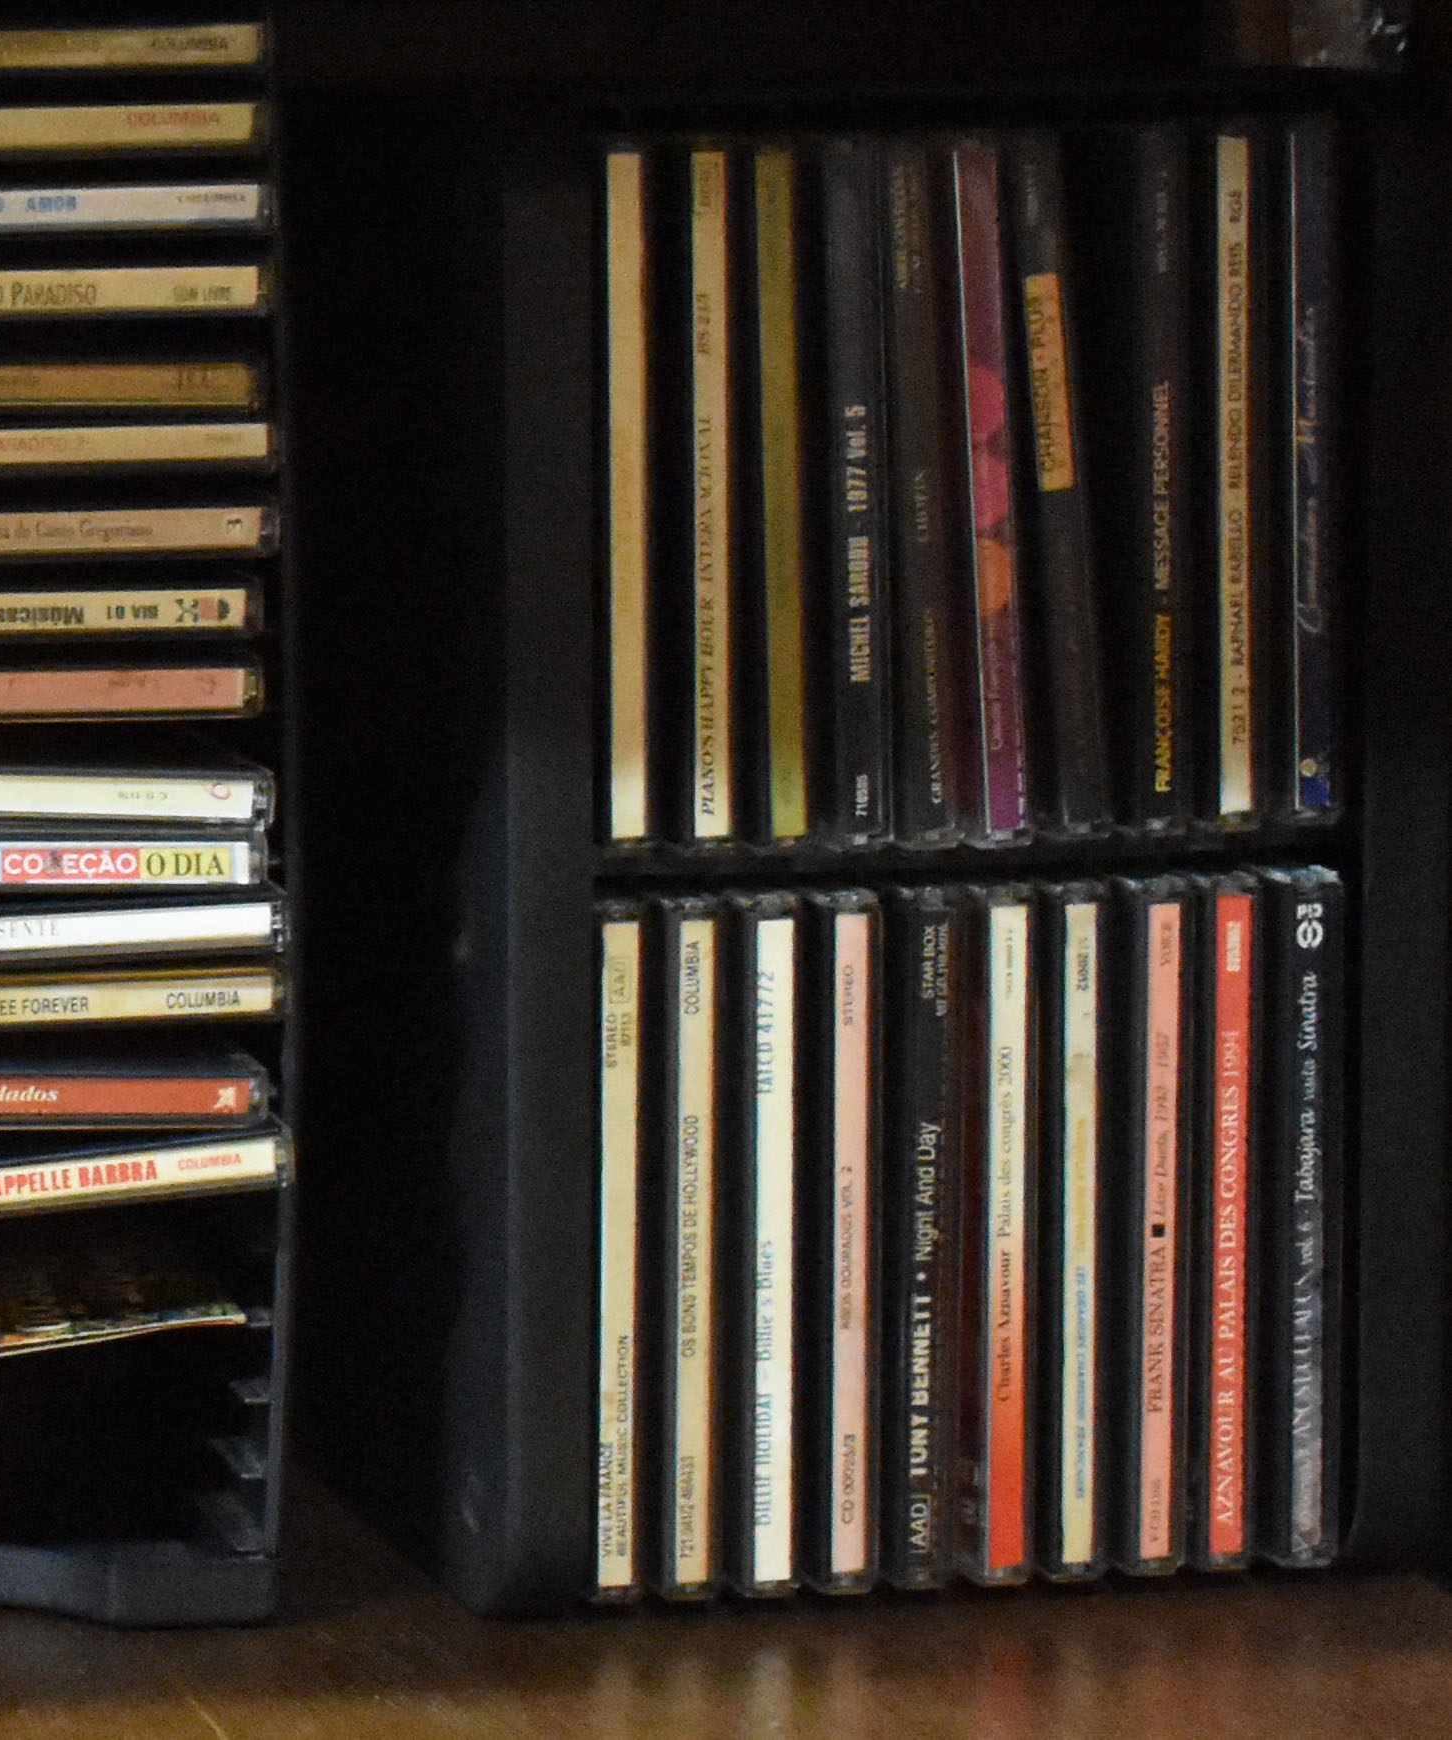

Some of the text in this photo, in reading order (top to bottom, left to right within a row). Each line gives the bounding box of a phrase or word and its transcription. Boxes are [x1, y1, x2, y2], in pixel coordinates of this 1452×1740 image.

[844, 406, 866, 417] 5
[846, 425, 867, 460] Vol.
[846, 466, 869, 512] 1977
[1153, 381, 1174, 792] FRANÇOISE HARDY MESSAGE PERSONNEL
[848, 616, 871, 682] MICHEL
[3, 849, 224, 878] COEÇÃO O DIA
[922, 926, 936, 959] BOX
[684, 941, 701, 1015] COLUMBIA
[22, 996, 89, 1016] FOREVER
[166, 991, 240, 1010] COLUMBIA
[996, 1047, 1012, 1086] 2000
[1222, 1031, 1239, 1078] 1994
[78, 1160, 157, 1189] BARBRA
[178, 1154, 241, 1171] COLUMBIA
[996, 1159, 1013, 1187] des
[681, 1115, 699, 1358] OS BONS TEMPOS DE HOLLYWOOD
[996, 1192, 1013, 1238] Palais
[1220, 1205, 1238, 1248] DES
[996, 1250, 1013, 1330] Aznavour
[1218, 1255, 1238, 1338] PALAIS
[1217, 1346, 1237, 1381] AU
[616, 1336, 629, 1557] BEAUTIFUL MUSIC COLLECTION
[1216, 1388, 1237, 1524] AZNAVOUR
